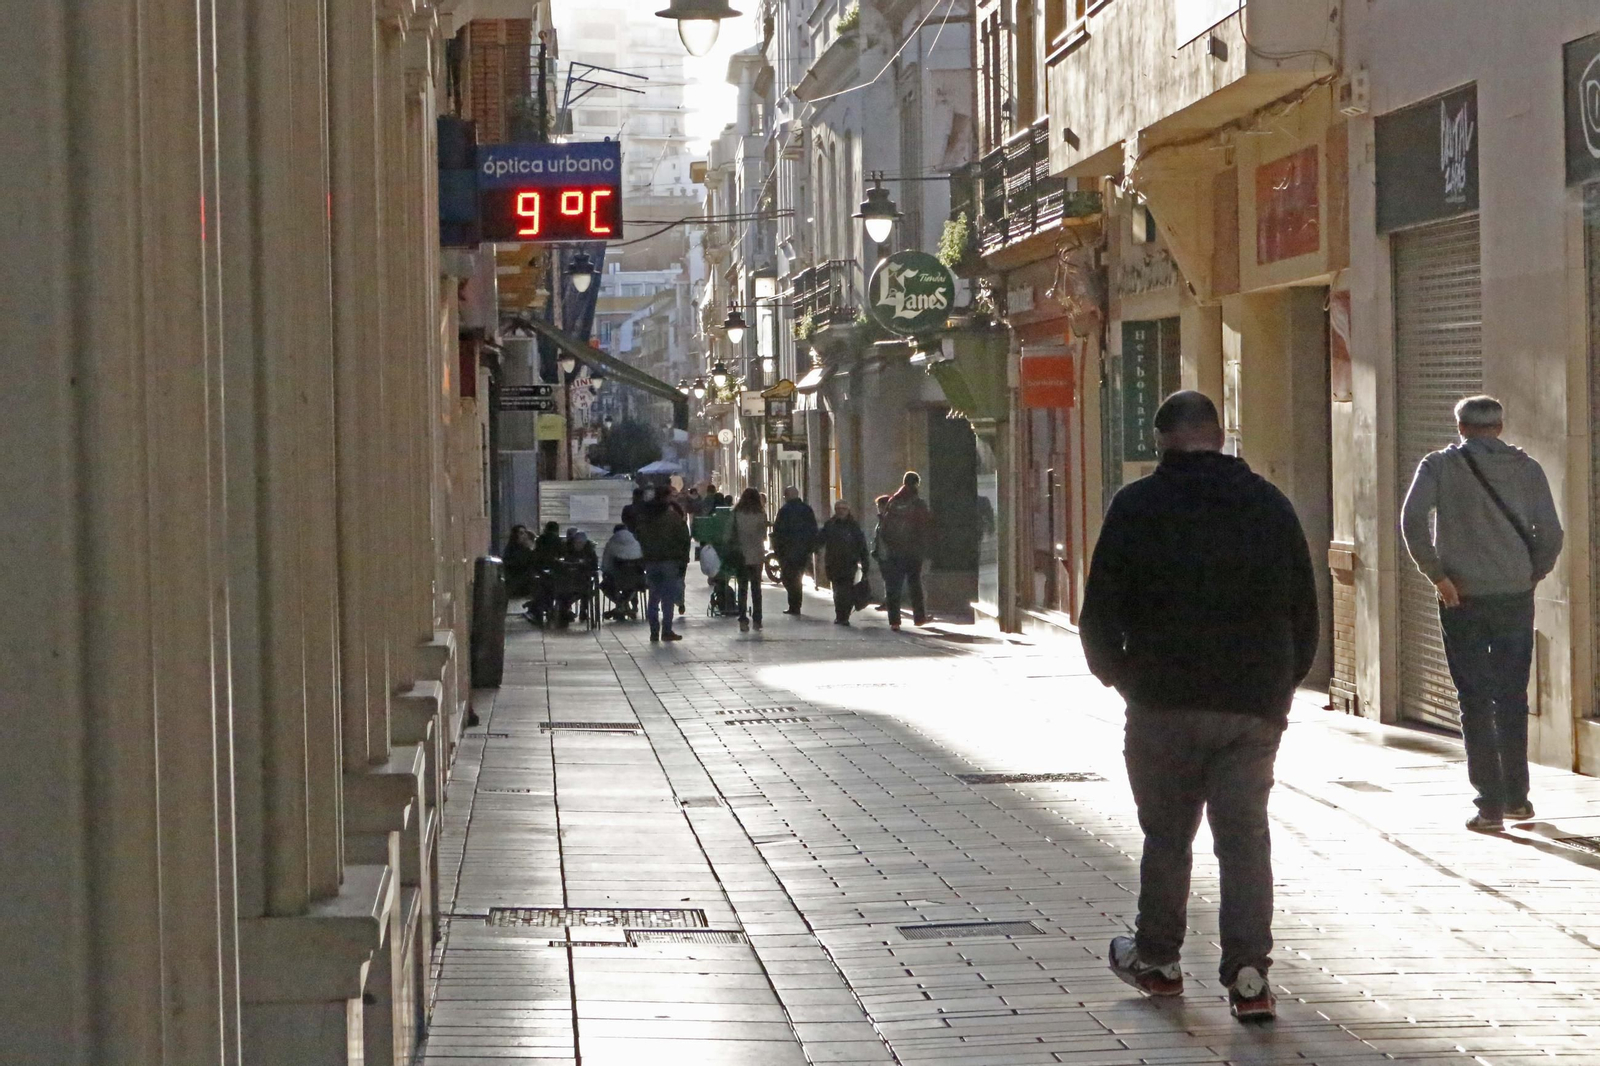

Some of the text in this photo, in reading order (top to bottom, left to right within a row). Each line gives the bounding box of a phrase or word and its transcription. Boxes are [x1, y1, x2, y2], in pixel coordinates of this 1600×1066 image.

[483, 155, 614, 178] óptica urbano
[517, 192, 540, 235] 9
[919, 272, 946, 283] Tiendas
[1135, 330, 1146, 451] Herbolario
